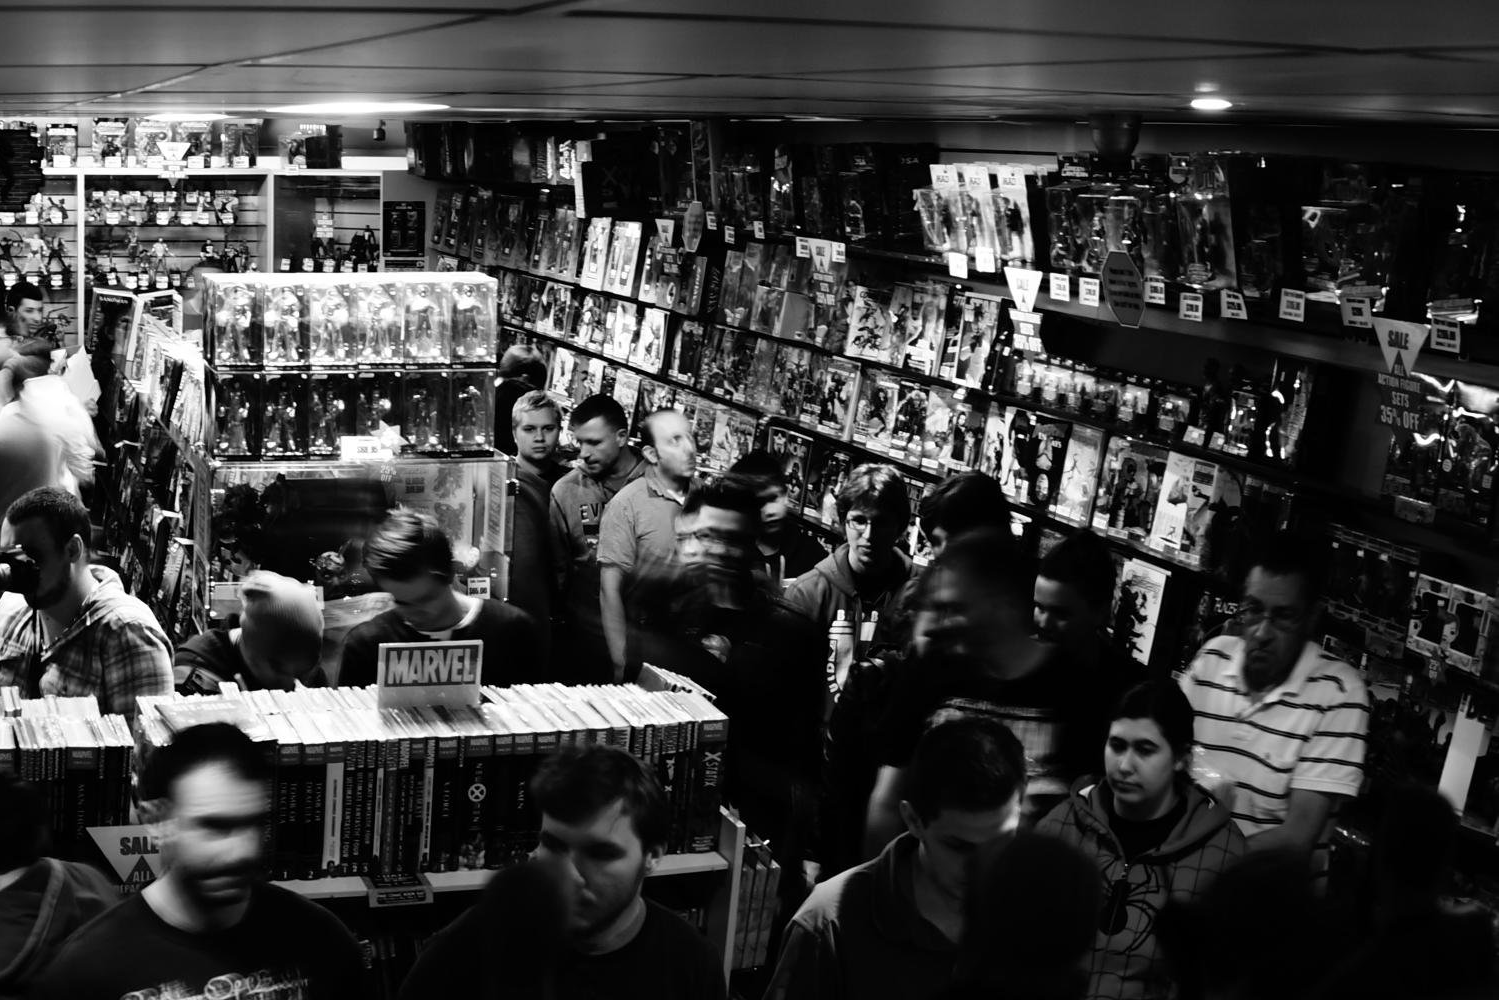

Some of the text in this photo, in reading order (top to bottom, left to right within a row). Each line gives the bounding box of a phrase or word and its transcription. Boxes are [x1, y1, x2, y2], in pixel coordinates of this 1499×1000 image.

[1388, 330, 1409, 350] SALE
[1391, 391, 1409, 408] SETS
[1380, 404, 1420, 431] 35% OFF
[387, 648, 475, 685] MARVEL
[120, 836, 159, 855] SALE
